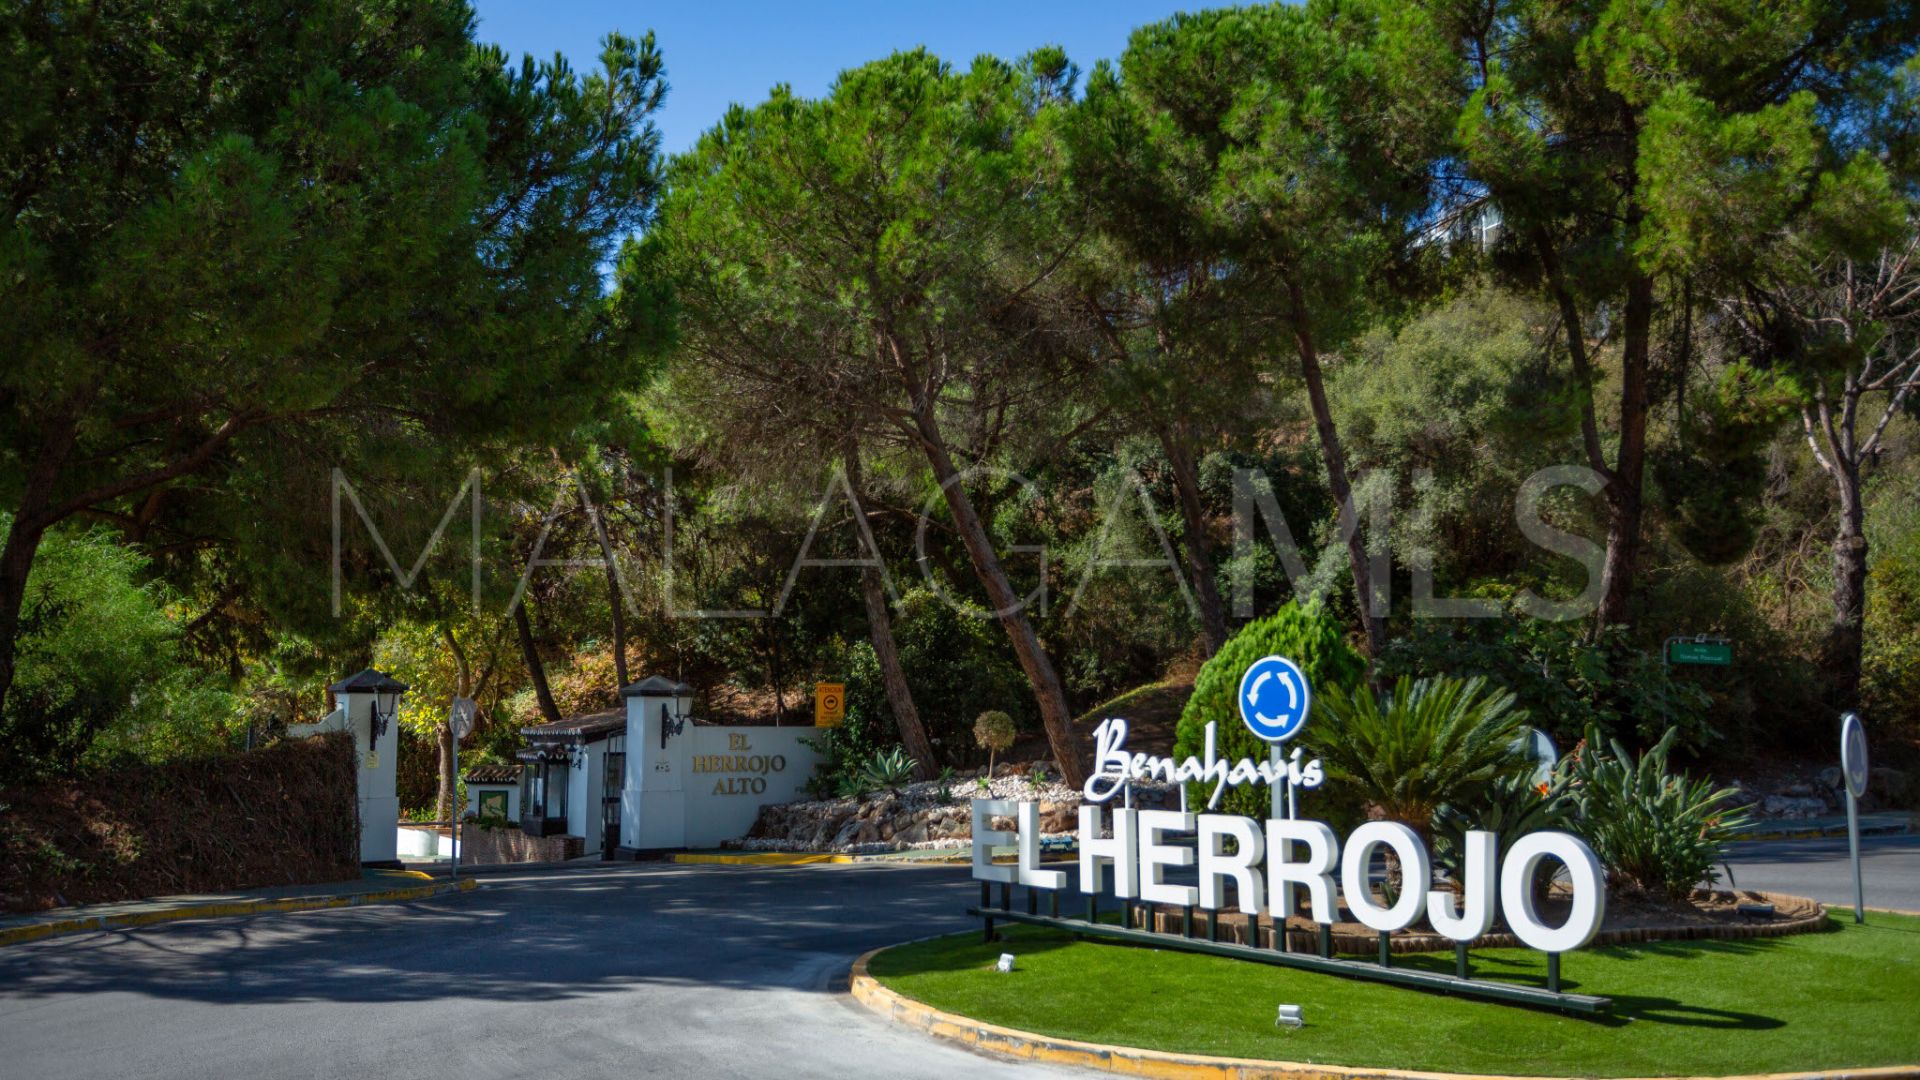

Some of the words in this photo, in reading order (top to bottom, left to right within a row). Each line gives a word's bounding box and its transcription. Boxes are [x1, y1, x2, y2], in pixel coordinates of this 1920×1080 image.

[728, 733, 752, 751] EL
[692, 755, 786, 774] HERROJO
[712, 777, 767, 795] ALTO
[972, 799, 1066, 889] EL
[1079, 805, 1604, 952] HERROJO
